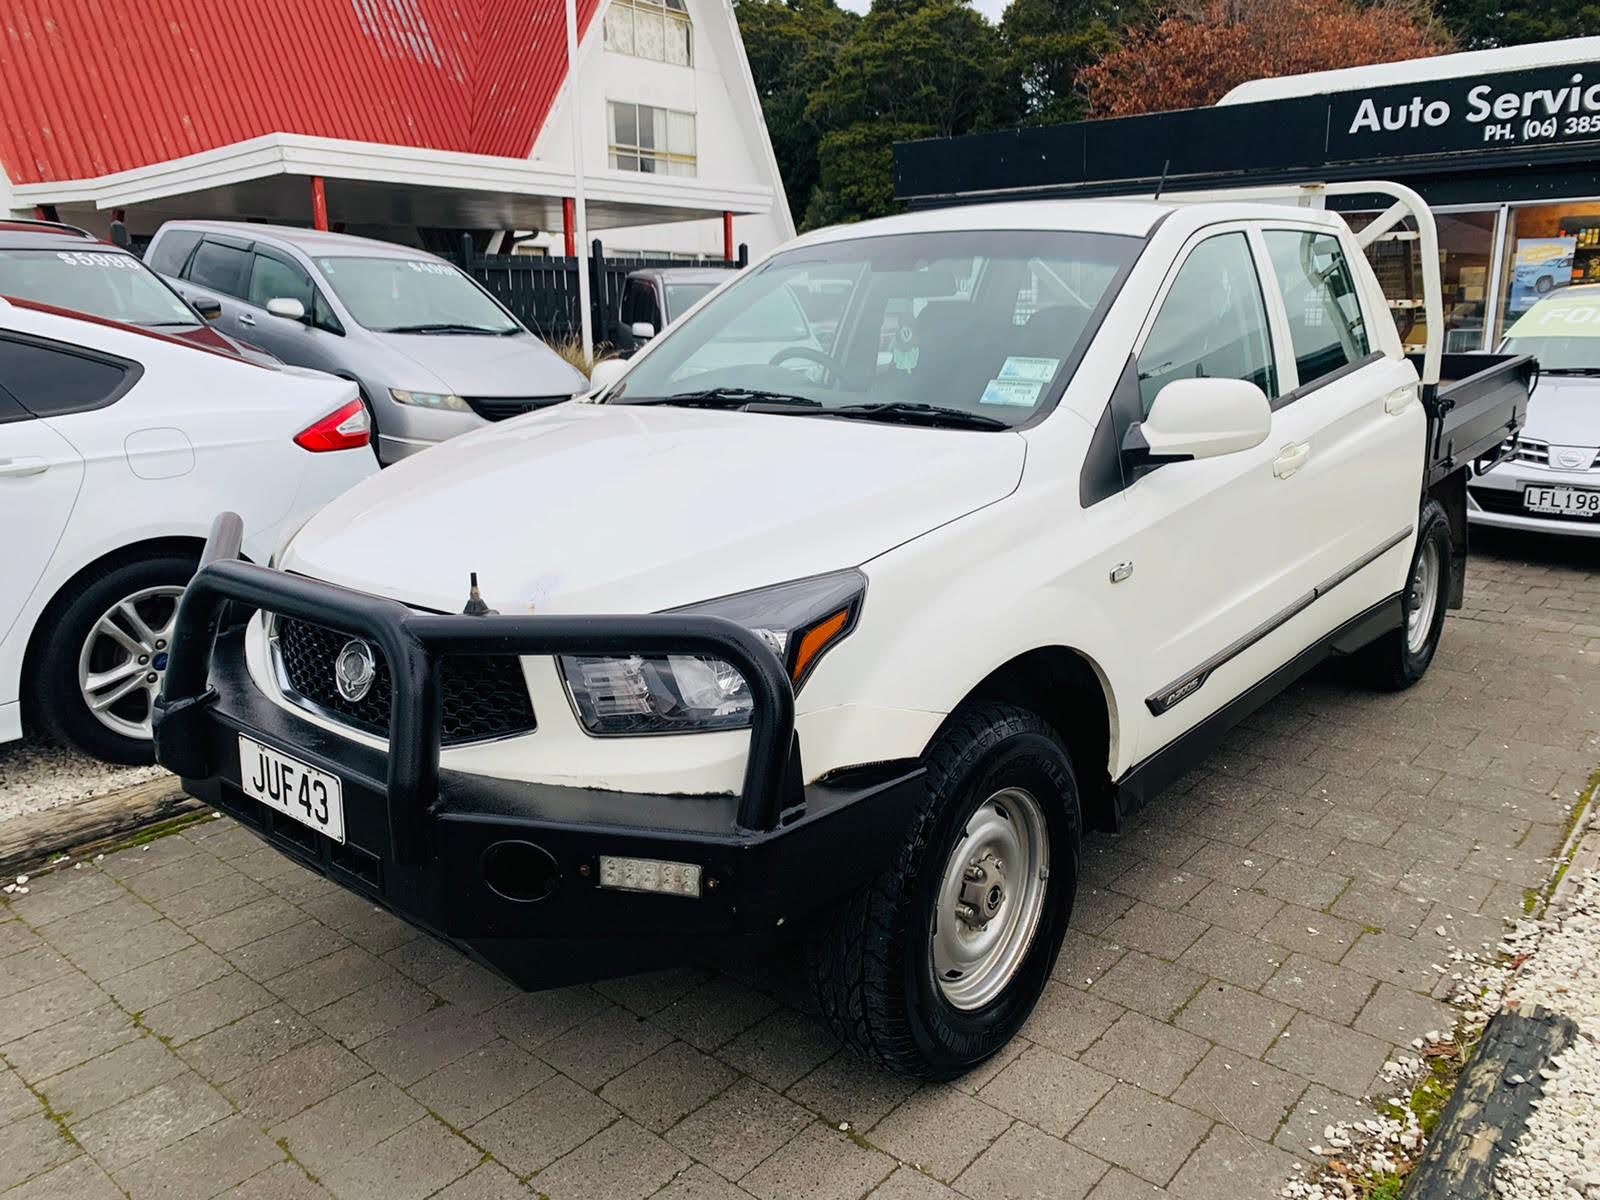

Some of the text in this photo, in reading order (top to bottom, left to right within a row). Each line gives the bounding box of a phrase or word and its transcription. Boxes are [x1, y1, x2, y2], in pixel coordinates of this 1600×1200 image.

[1349, 97, 1450, 134] Auto
[1484, 115, 1600, 142] PH. (06) 385
[56, 251, 140, 270] $5995
[1540, 306, 1600, 326] FO
[1526, 489, 1600, 511] LFL198
[252, 752, 329, 825] JUF43
